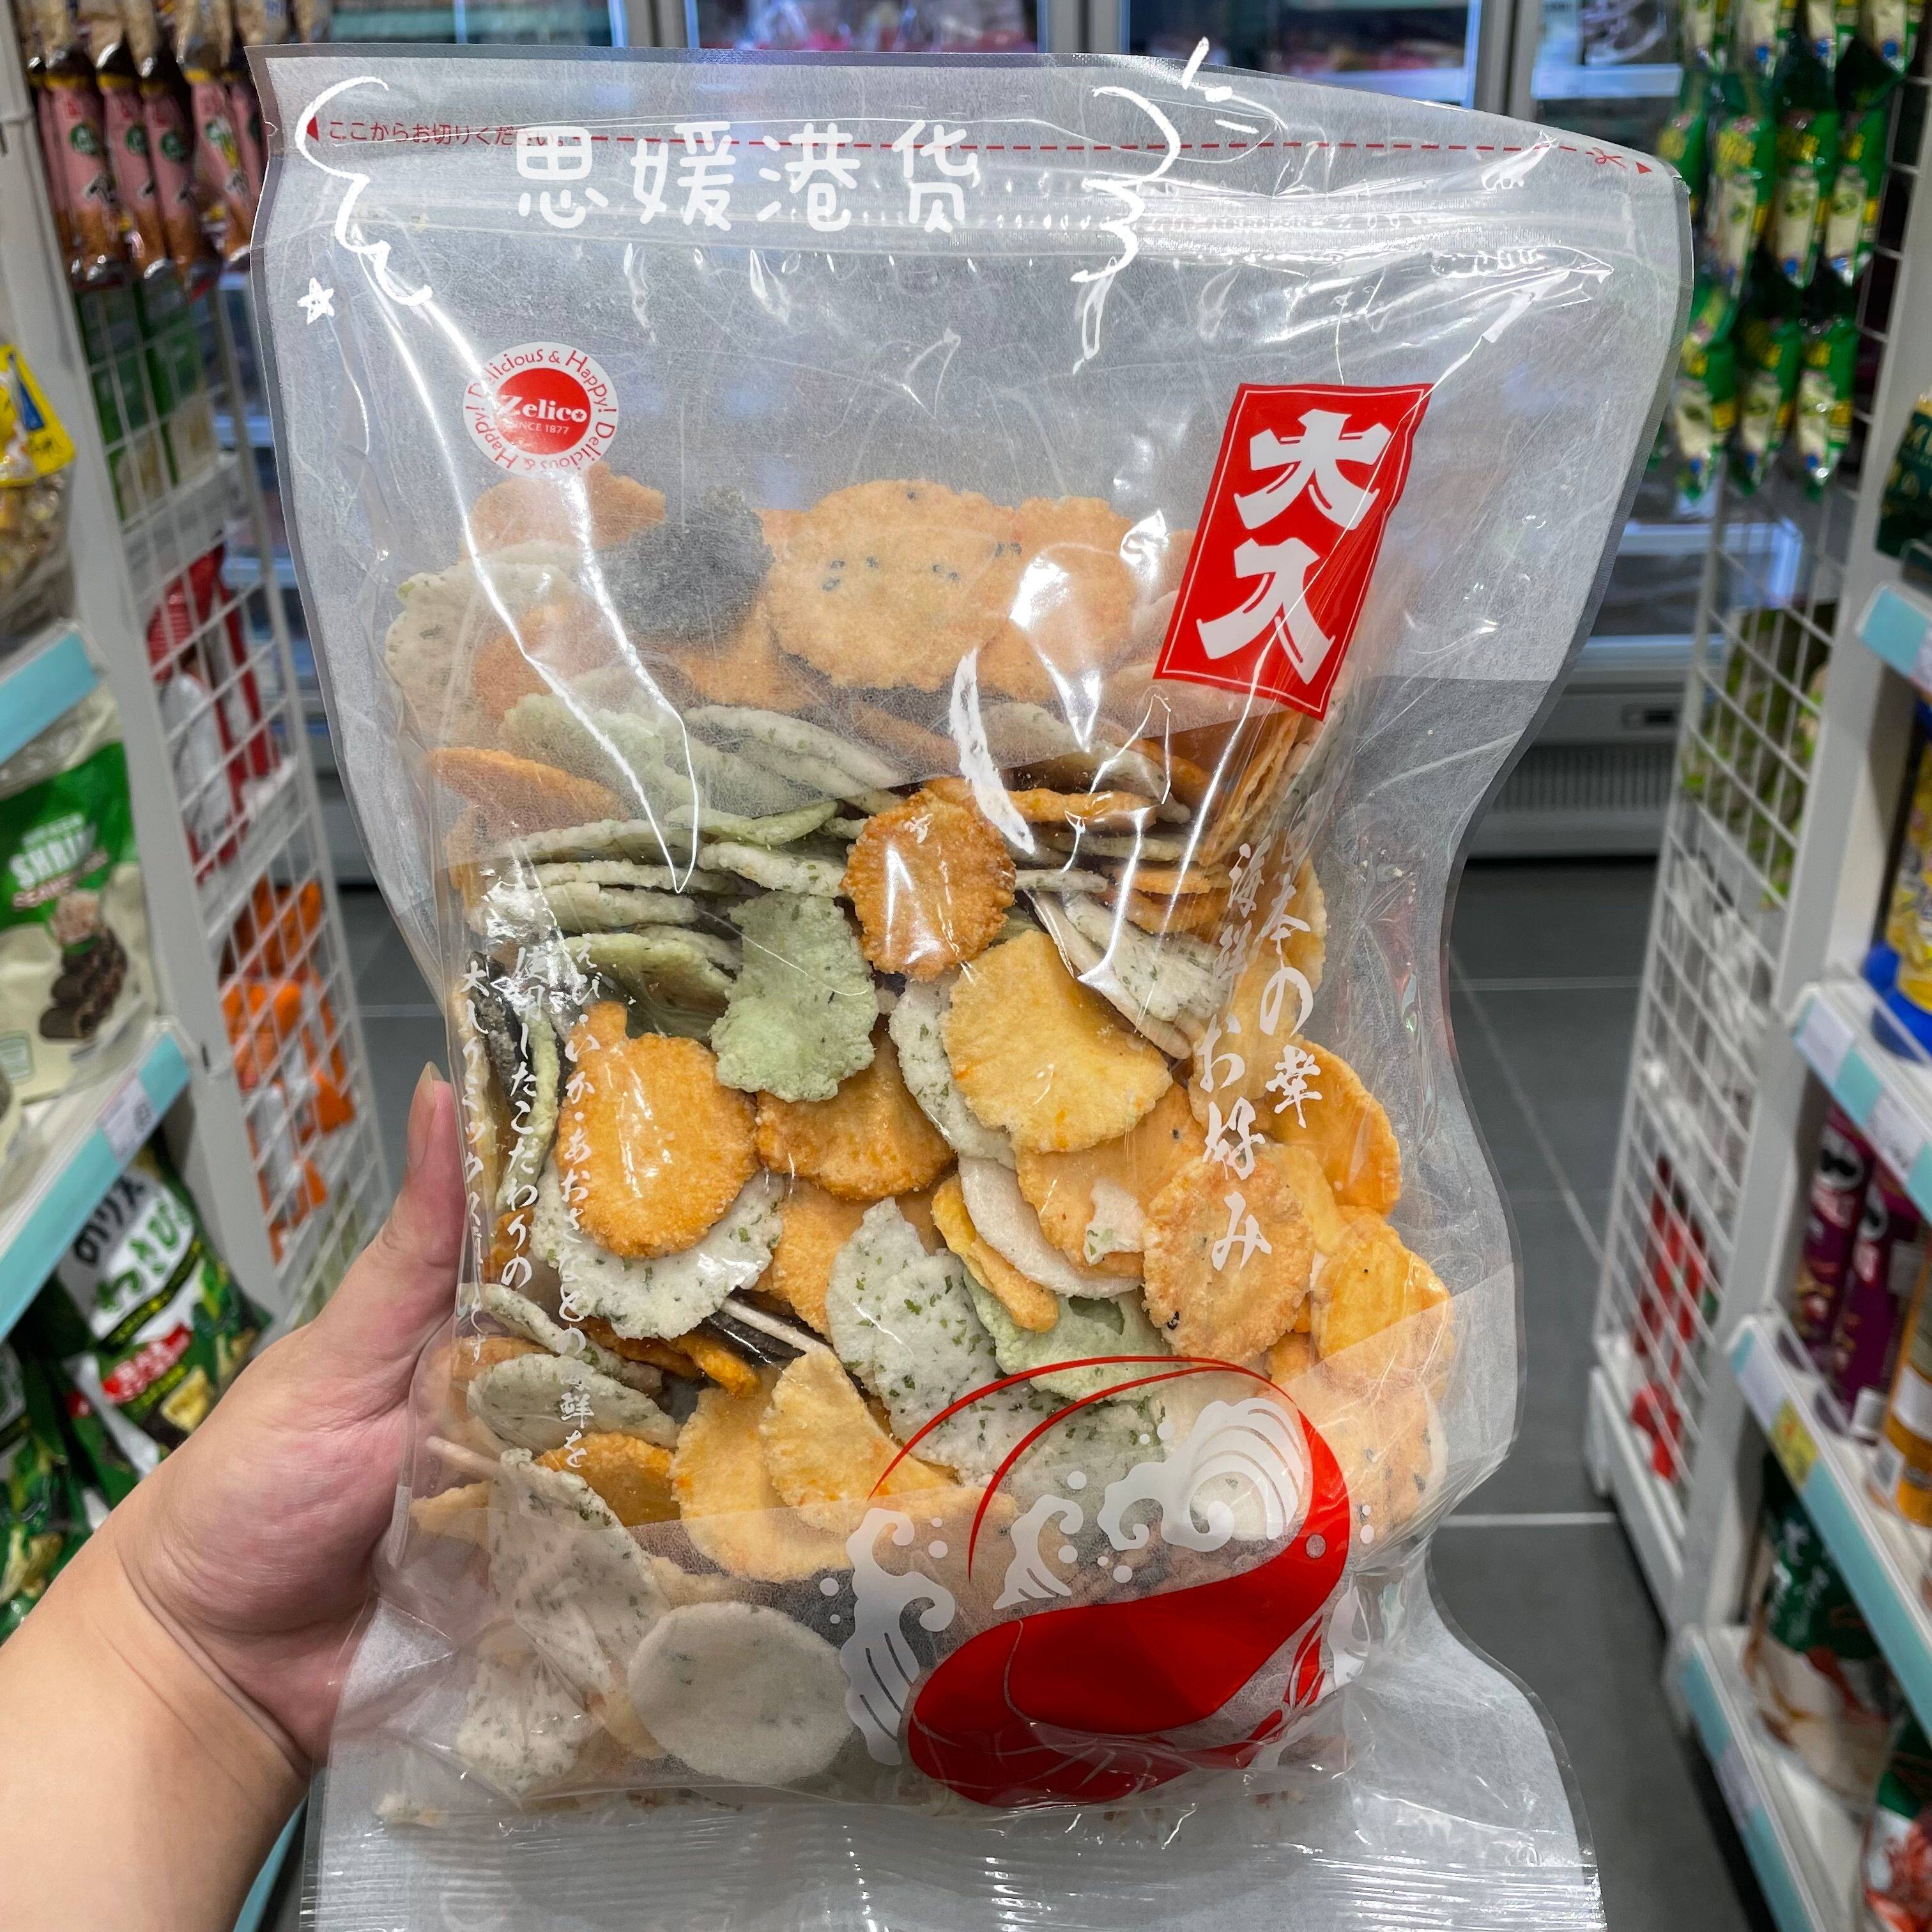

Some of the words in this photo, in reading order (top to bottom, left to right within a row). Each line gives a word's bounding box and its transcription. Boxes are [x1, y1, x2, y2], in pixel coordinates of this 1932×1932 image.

[468, 349, 543, 398] Dlicious
[549, 350, 560, 364] &
[565, 349, 617, 413] Happy!
[496, 394, 587, 423] Zelico
[545, 424, 570, 435] 1877
[1197, 408, 1393, 685] 大入
